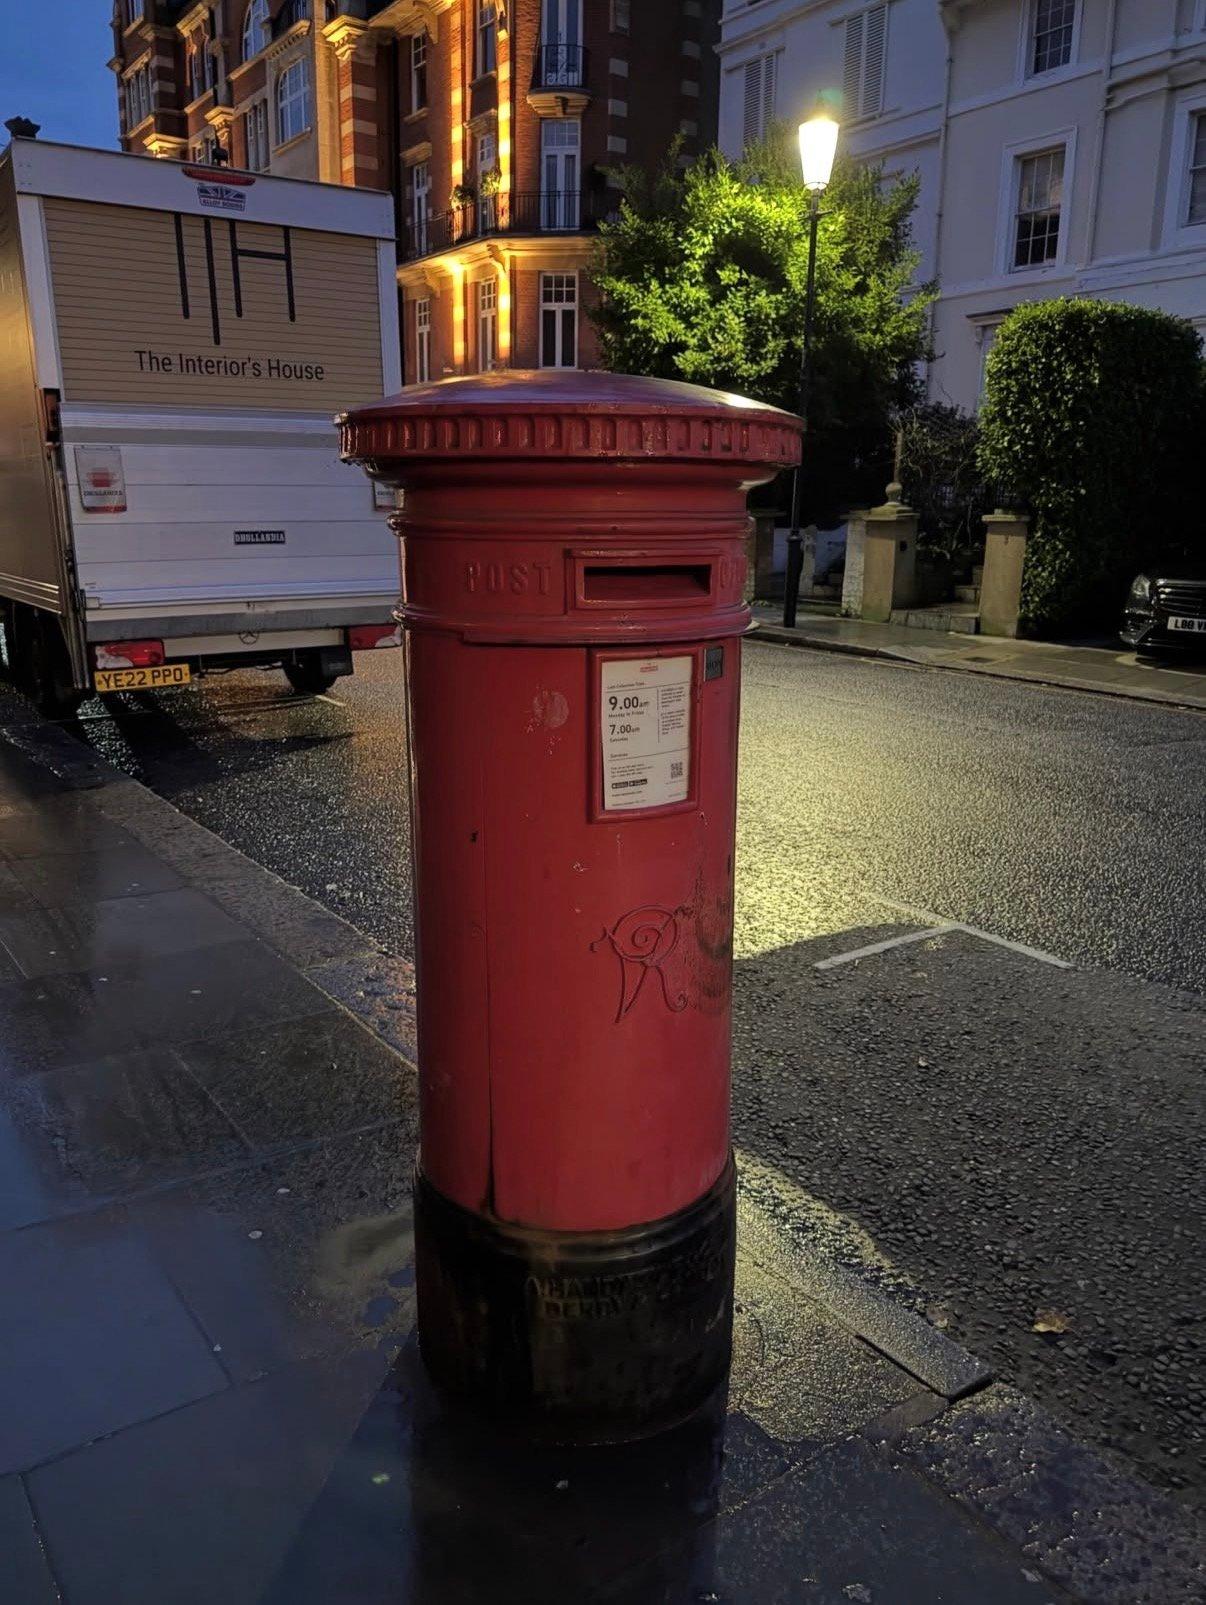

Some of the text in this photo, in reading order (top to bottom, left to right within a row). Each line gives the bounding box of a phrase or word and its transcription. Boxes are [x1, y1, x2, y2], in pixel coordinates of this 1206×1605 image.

[134, 350, 325, 381] The Interior's House
[464, 561, 551, 596] POST
[101, 668, 183, 688] YE22 PPO
